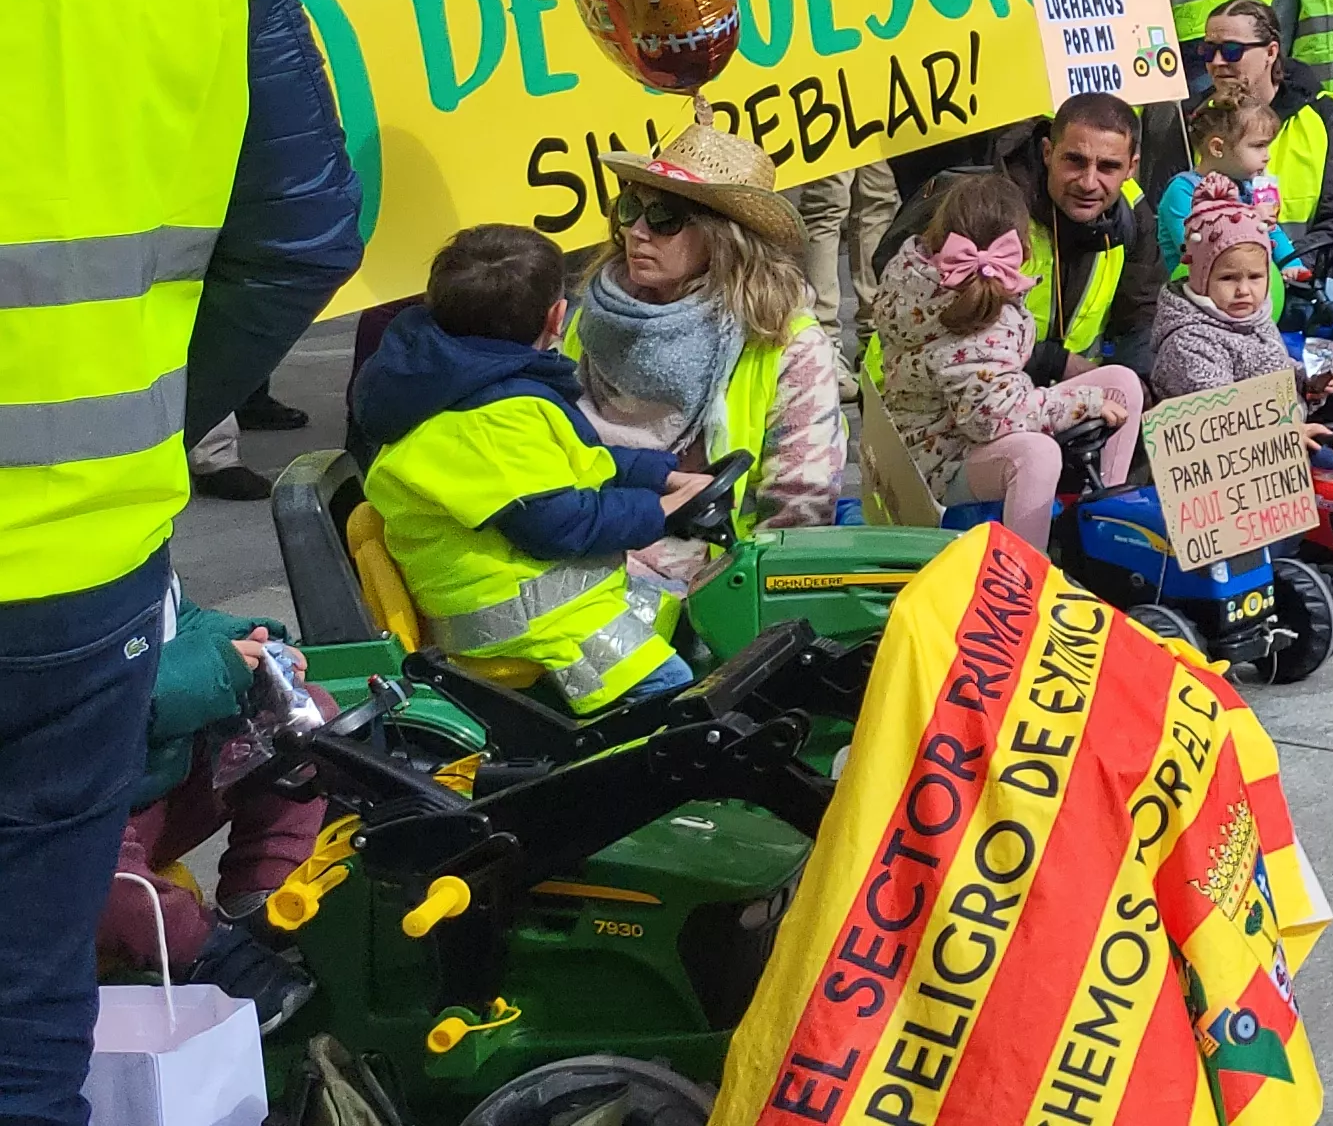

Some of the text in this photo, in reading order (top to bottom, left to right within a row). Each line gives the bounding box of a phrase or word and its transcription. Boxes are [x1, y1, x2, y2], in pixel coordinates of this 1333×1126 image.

[1063, 25, 1115, 55] POR MI
[1068, 64, 1123, 94] FUTURO
[1163, 399, 1281, 457] MIS CEREALES
[1169, 431, 1302, 494] PARA DESAYUNAR
[1180, 462, 1310, 534] AQUI SE TIENEN
[1187, 496, 1316, 564] QUE SEMBRAR
[770, 576, 844, 588] JOHN DEERE
[772, 548, 1034, 1124] EL SECTOR PRIMARIO
[593, 919, 644, 938] 7930
[864, 820, 1036, 1126] PELIGRO
[1000, 720, 1077, 800] DE
[1037, 893, 1163, 1126] HEMOS
[1131, 759, 1192, 866] OR
[1173, 721, 1211, 774] EL
